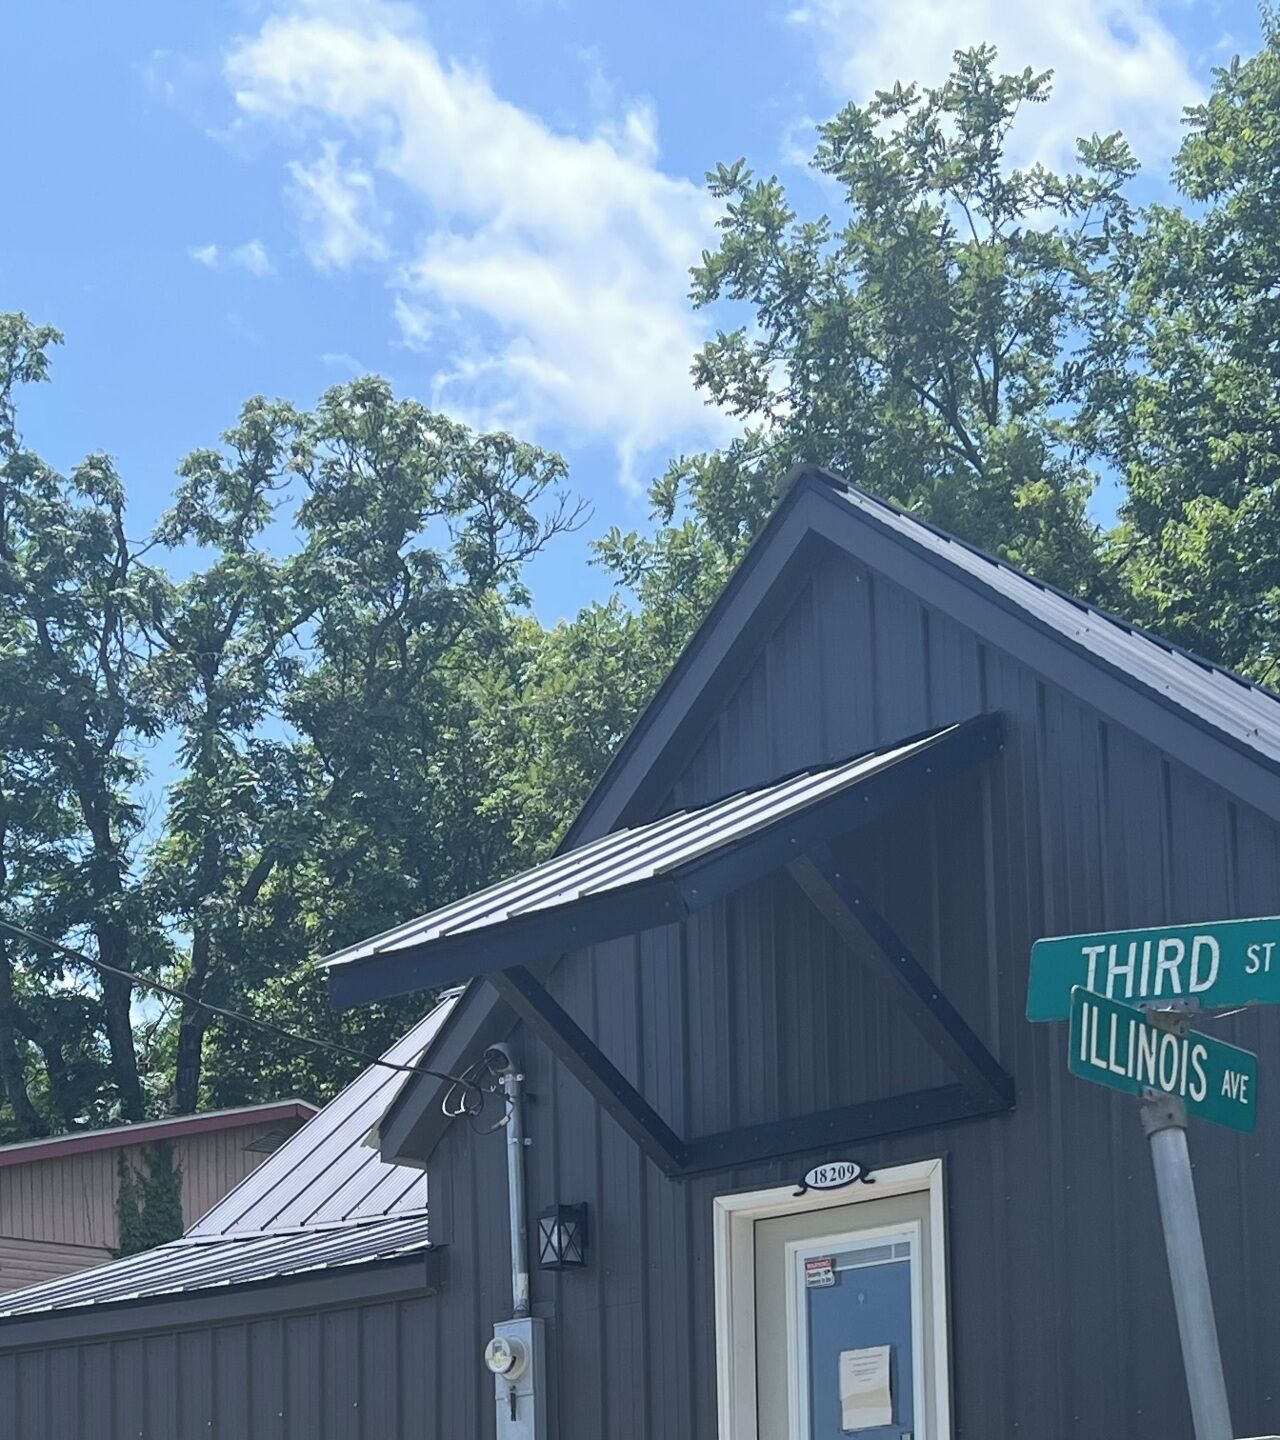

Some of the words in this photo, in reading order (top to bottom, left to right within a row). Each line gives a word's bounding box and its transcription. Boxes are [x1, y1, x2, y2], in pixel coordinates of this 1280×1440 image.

[1081, 935, 1220, 998] THIRD
[1245, 942, 1276, 974] ST
[1080, 1002, 1208, 1102] ILLINOIS
[1221, 1069, 1249, 1104] AVE
[813, 1164, 855, 1184] 18209
